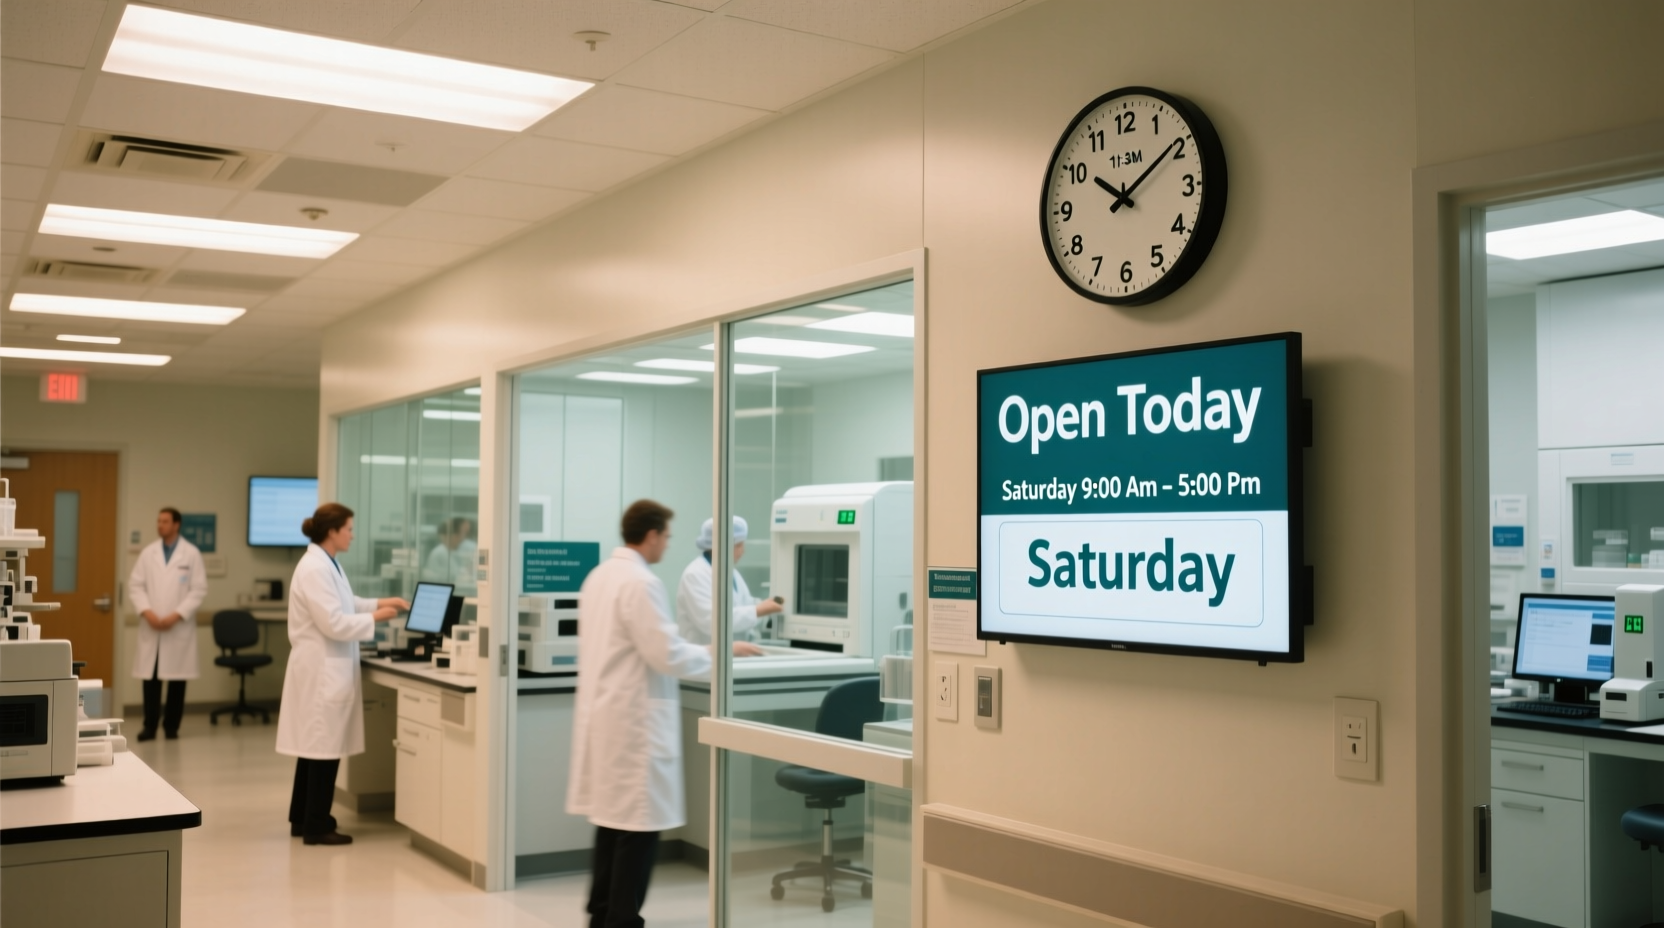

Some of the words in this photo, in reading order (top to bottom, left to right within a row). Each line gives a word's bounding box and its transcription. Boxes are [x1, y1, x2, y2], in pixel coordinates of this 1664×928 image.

[1114, 111, 1136, 135] 12
[1152, 114, 1159, 135] 1
[1088, 130, 1104, 152] 11
[1173, 137, 1186, 160] 2
[1069, 162, 1087, 185] 10
[1182, 174, 1195, 197] 3
[1060, 201, 1073, 222] 9
[1171, 213, 1186, 235] 4
[1070, 235, 1083, 256] 8
[1150, 244, 1164, 268] 5
[1091, 256, 1103, 277] 7
[1120, 261, 1133, 283] 6
[999, 395, 1105, 454] Open
[1117, 376, 1262, 443] Today
[1002, 476, 1077, 505] Saturday
[1081, 476, 1121, 499] 9:00
[1126, 476, 1157, 497] Am
[1178, 472, 1221, 496] 5:00
[1227, 472, 1261, 495] Pm
[1028, 537, 1235, 607] Saturday
